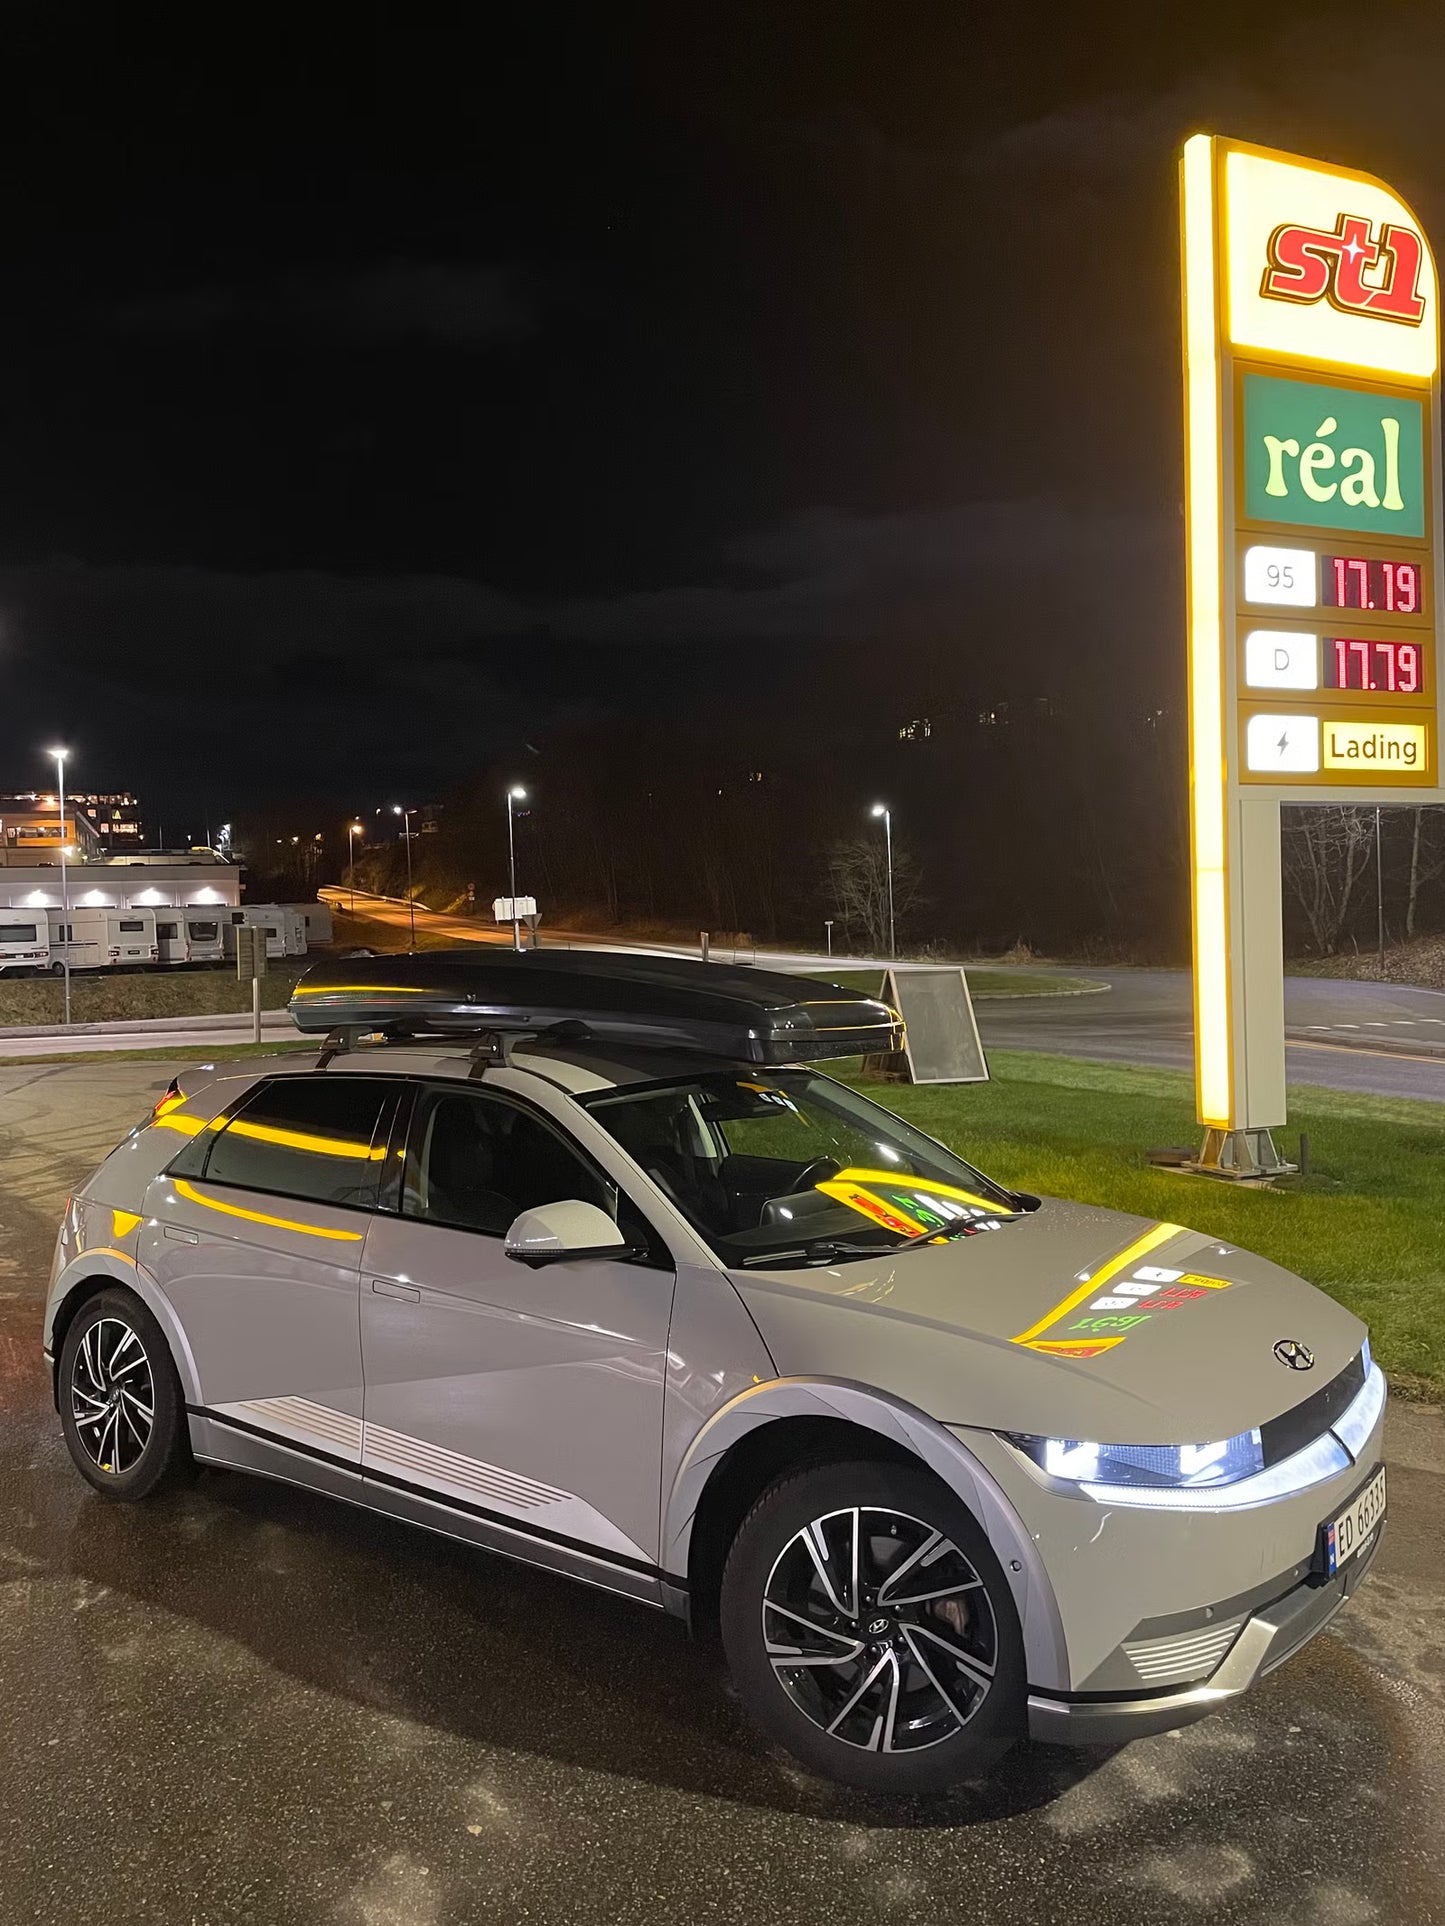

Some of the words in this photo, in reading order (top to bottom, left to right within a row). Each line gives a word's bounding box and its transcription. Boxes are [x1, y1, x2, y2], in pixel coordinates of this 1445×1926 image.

[1263, 416, 1405, 511] réal
[1266, 564, 1295, 589] 95
[1334, 558, 1416, 612] 17.19
[1274, 648, 1290, 671] D
[1335, 641, 1417, 692] 17.79
[1331, 733, 1417, 765] Lading
[1338, 1515, 1353, 1556] ED
[1358, 1476, 1384, 1535] 66335
